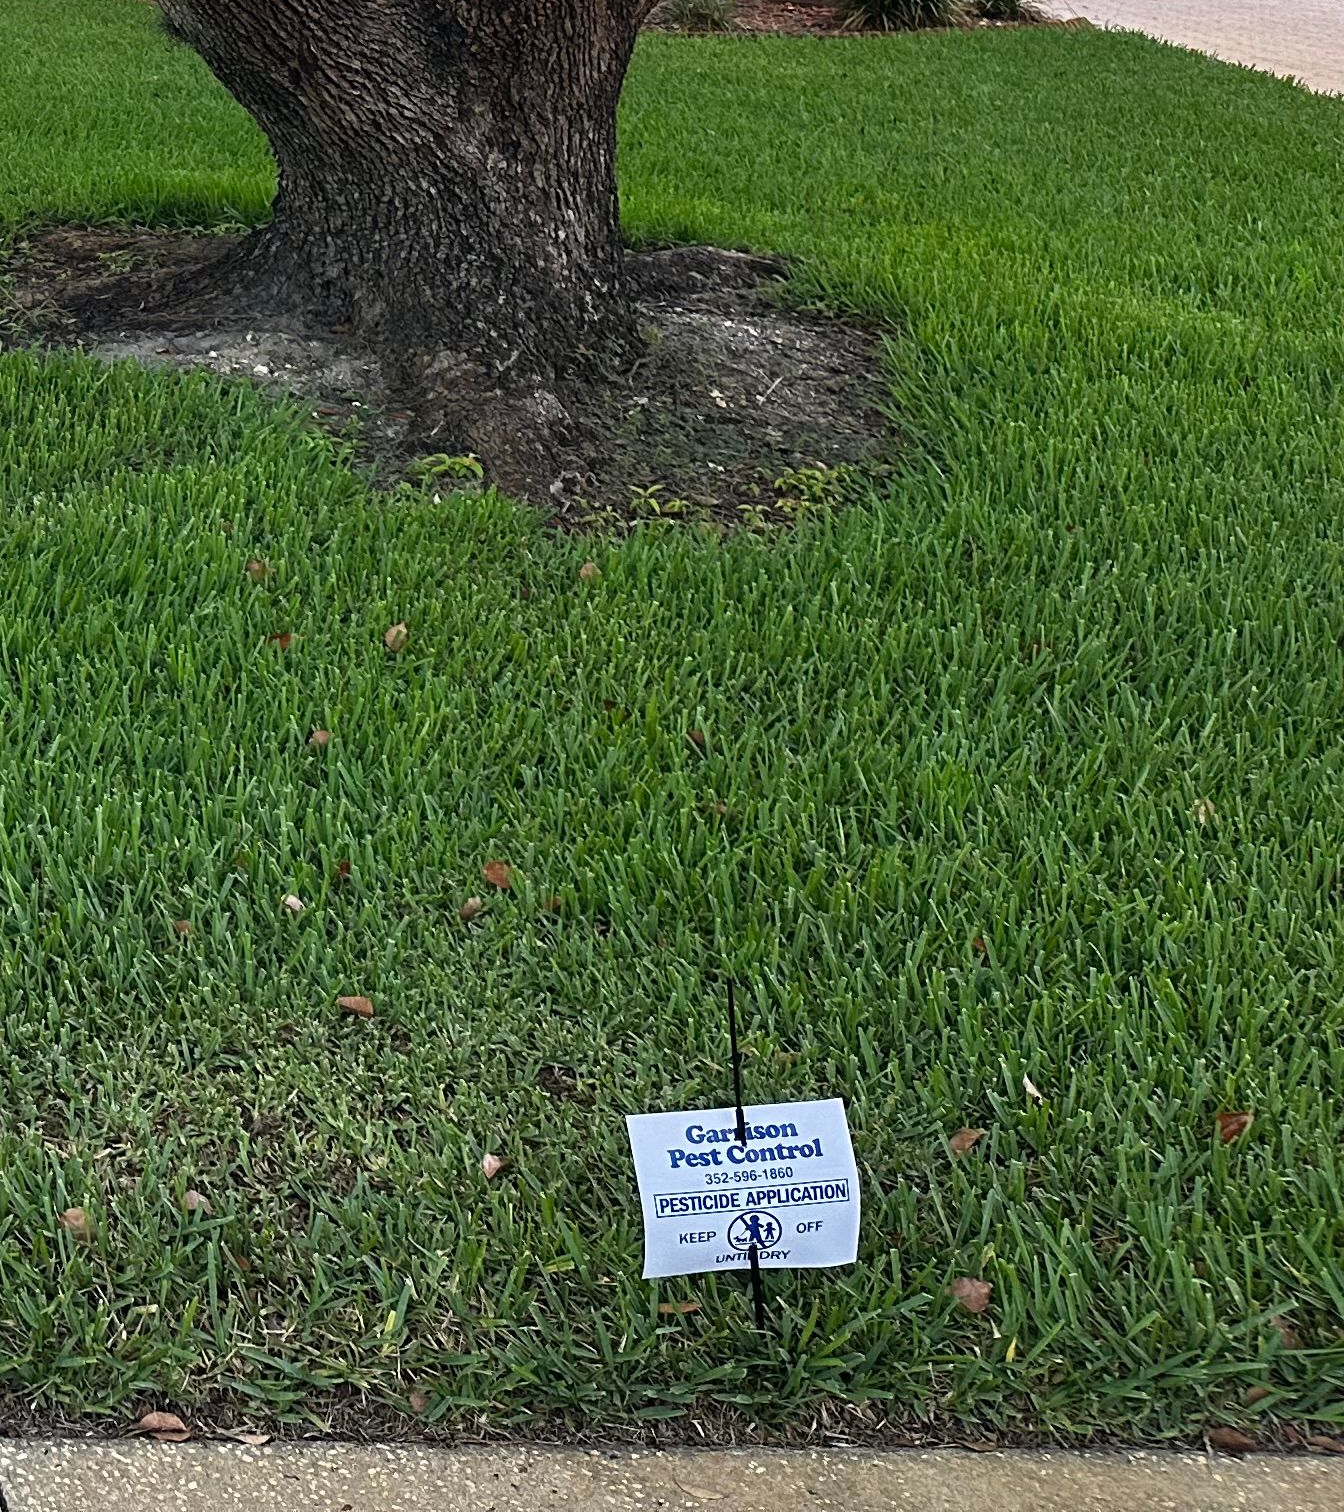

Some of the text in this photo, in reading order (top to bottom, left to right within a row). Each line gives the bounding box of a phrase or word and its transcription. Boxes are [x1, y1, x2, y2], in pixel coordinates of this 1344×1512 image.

[667, 1138, 824, 1169] Pest Control
[704, 1166, 794, 1186] 352-596-1860
[658, 1182, 847, 1214] PESTICIDE APPLICATION
[679, 1220, 824, 1244] KEEP OFF
[715, 1249, 792, 1264] UNTI DRY
